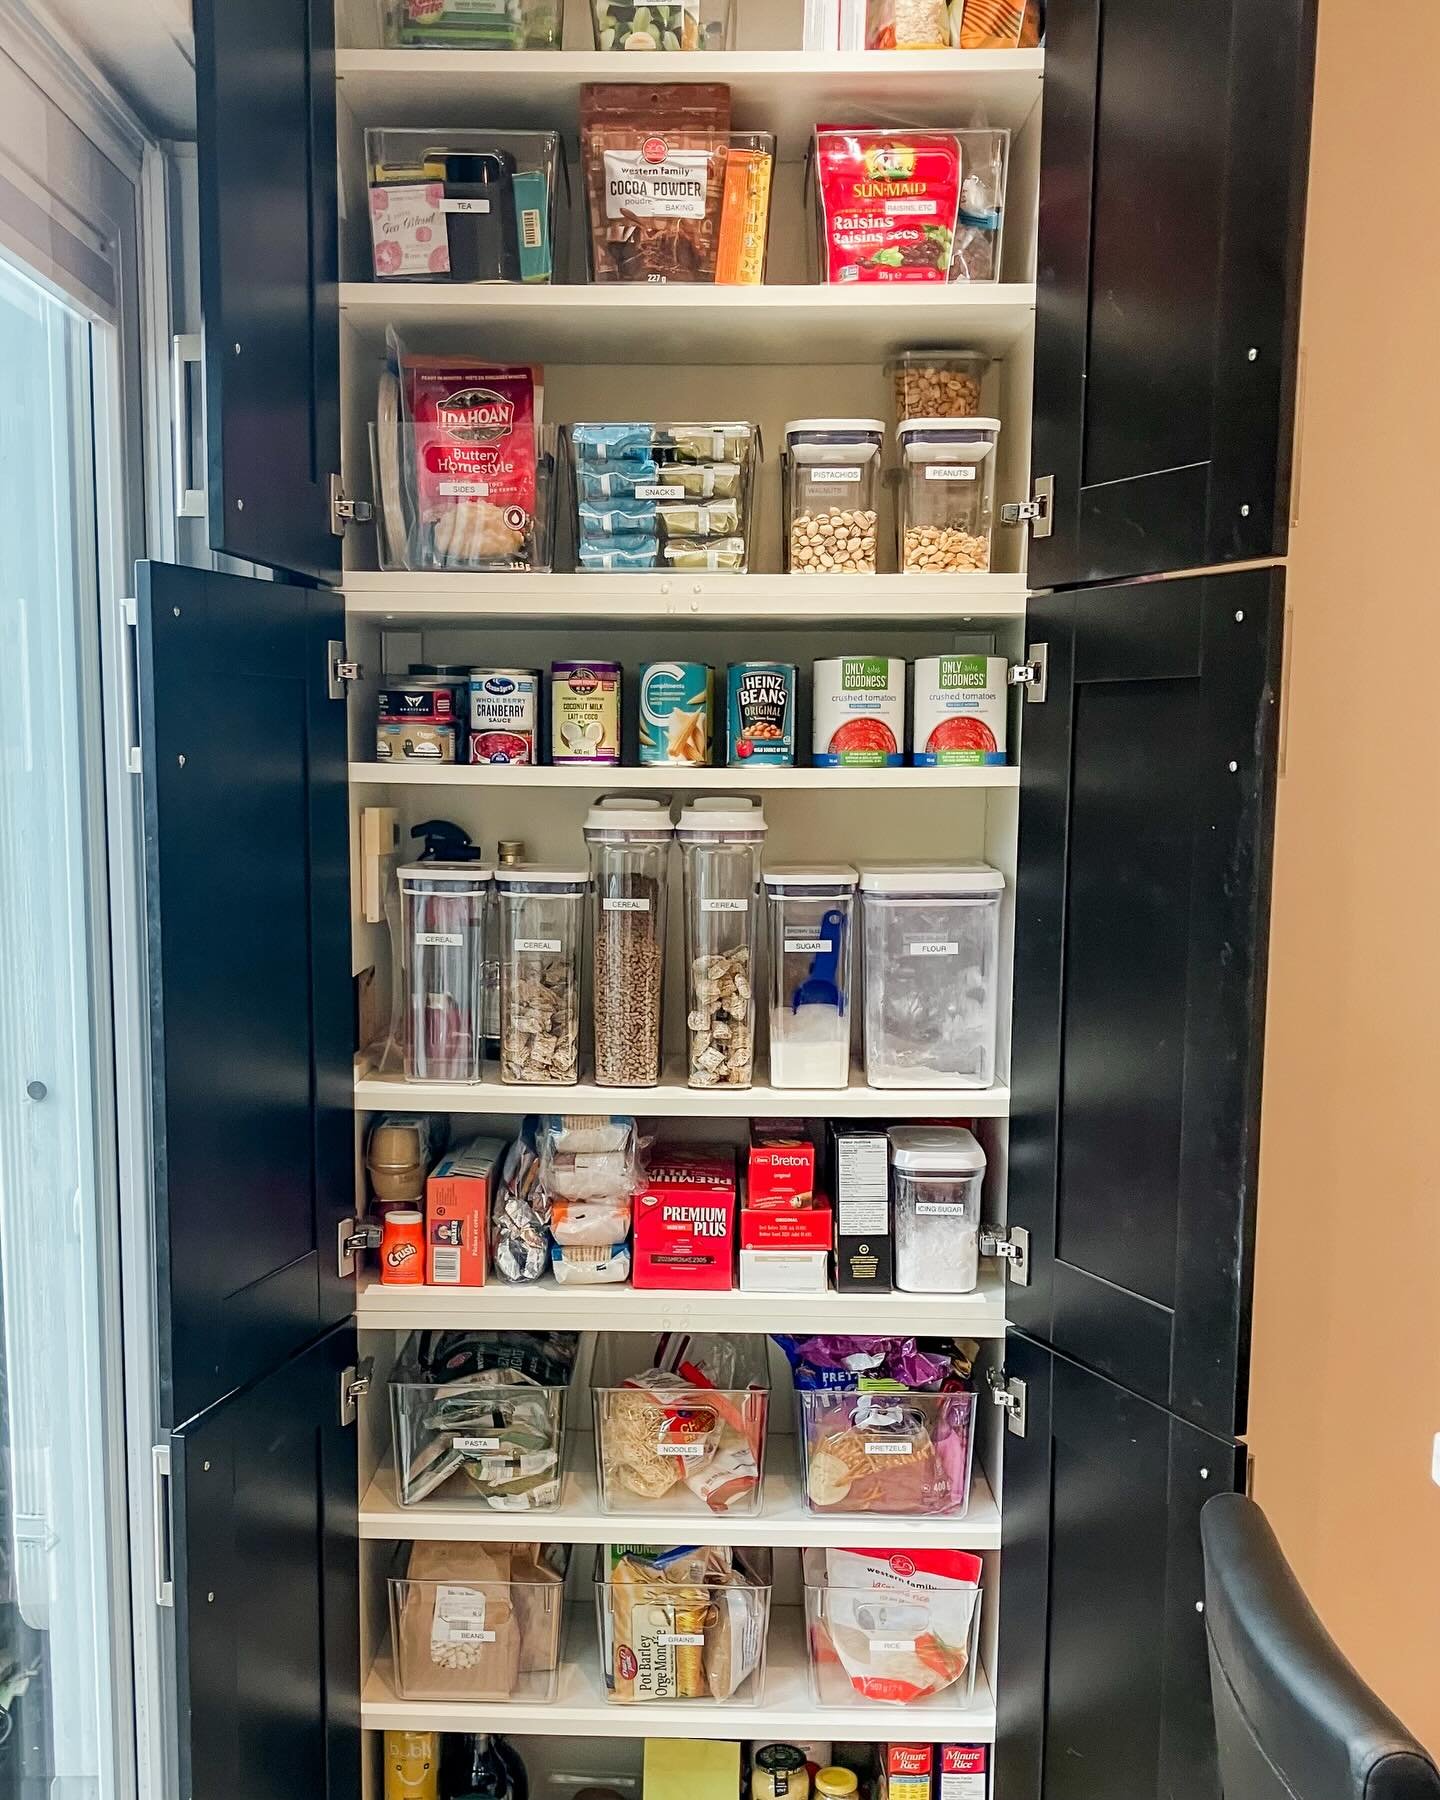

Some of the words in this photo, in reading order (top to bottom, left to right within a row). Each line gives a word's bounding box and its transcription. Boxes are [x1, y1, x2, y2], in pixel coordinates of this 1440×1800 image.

[661, 167, 690, 177] family
[610, 180, 648, 196] COCOA
[653, 182, 701, 197] POWDER
[833, 213, 895, 230] Raisins
[832, 230, 884, 244] Raisins
[886, 229, 919, 241] secs
[648, 274, 660, 282] 227
[661, 276, 667, 284] g
[441, 406, 510, 424] IDAHOAN
[453, 448, 499, 463] Buttery
[438, 459, 514, 476] Homestyle
[932, 469, 969, 477] PEANUTS
[813, 471, 859, 479] PISTACHIOS
[807, 486, 842, 494] WALNUTS
[845, 662, 864, 675] ONLY
[942, 661, 962, 674] ONLY
[745, 675, 784, 690] HEINZ
[740, 689, 786, 706] BEANS
[476, 704, 525, 718] CRANBERRY
[563, 702, 588, 710] COCONUT
[744, 704, 780, 716] ORIGINAL
[772, 1154, 810, 1166] Breton
[663, 1206, 727, 1222] PREMIUM
[450, 1220, 458, 1244] QUAKER
[694, 1222, 726, 1236] PLUS
[388, 1244, 417, 1266] Crush
[866, 1566, 904, 1582] western
[638, 1635, 654, 1672] Barley
[640, 1673, 652, 1691] Pot
[655, 1672, 670, 1696] Orge
[893, 1750, 926, 1761] Minute
[946, 1750, 980, 1760] Minute
[900, 1760, 920, 1770] Rice
[952, 1760, 973, 1769] Rice
